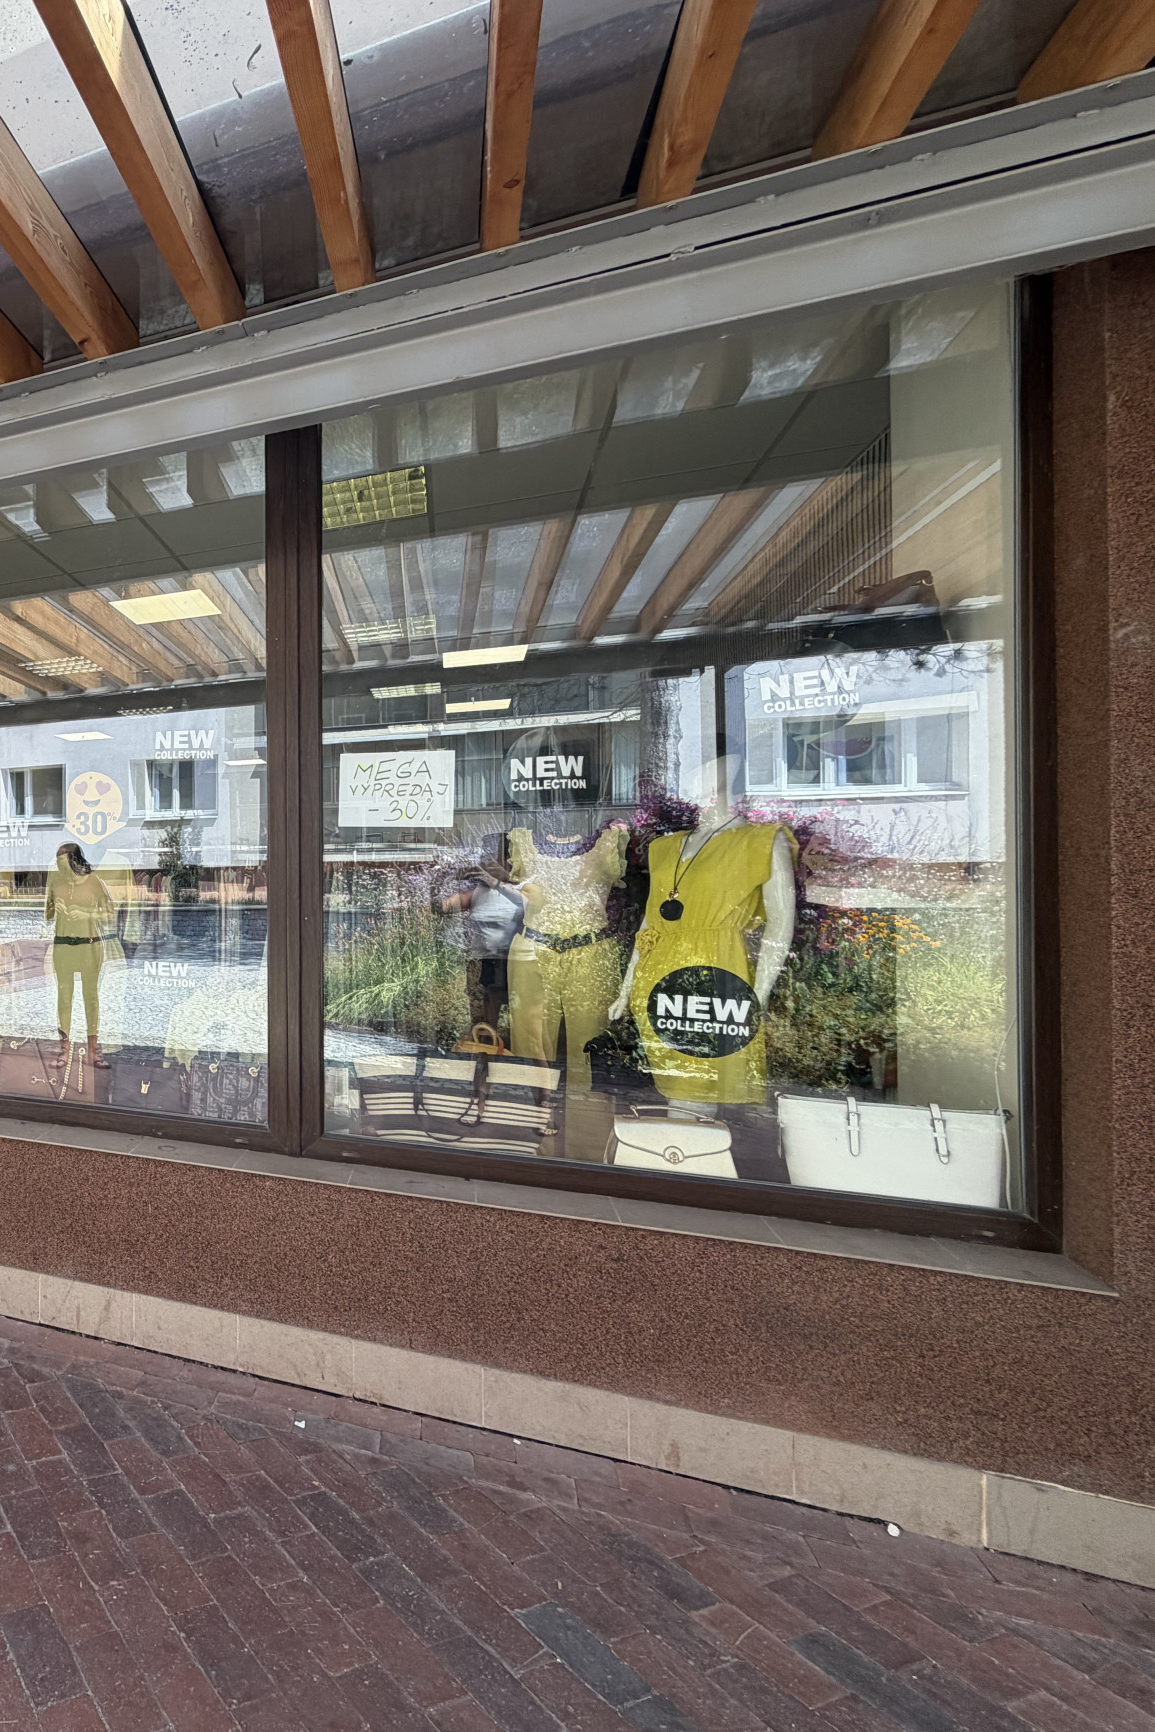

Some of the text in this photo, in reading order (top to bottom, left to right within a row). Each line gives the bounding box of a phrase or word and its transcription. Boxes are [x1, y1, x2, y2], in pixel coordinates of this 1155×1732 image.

[759, 665, 858, 701] NEW
[763, 692, 860, 714] COLLECTION
[154, 730, 215, 750] NEW
[155, 750, 214, 759] COLLECTION
[353, 757, 432, 781] MEGA
[510, 755, 584, 780] NEW
[511, 779, 587, 792] COLLECTION
[144, 961, 188, 976] NEW
[138, 977, 196, 987] COLLECTION
[656, 993, 751, 1023] NEW
[657, 1018, 750, 1037] COLLECTION
